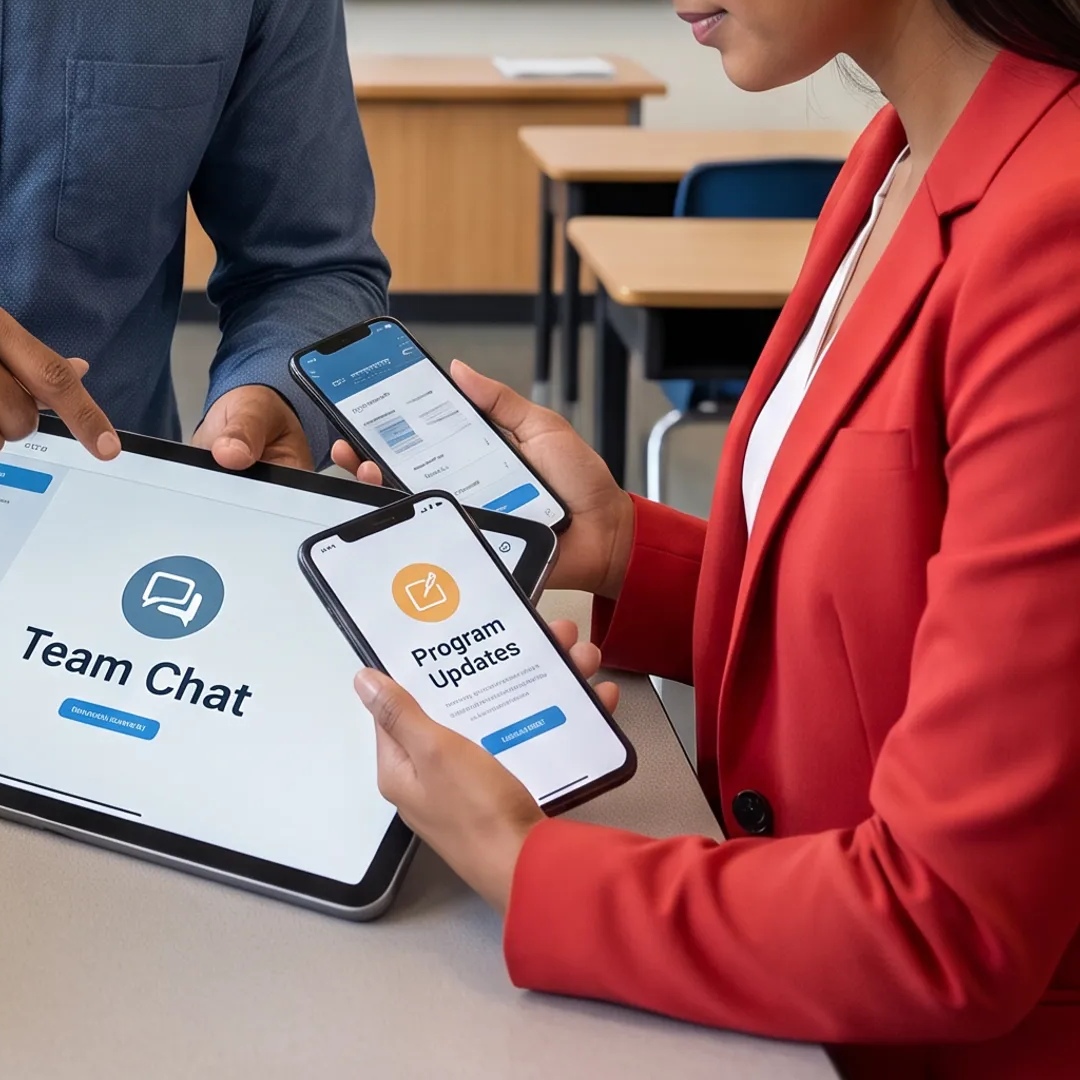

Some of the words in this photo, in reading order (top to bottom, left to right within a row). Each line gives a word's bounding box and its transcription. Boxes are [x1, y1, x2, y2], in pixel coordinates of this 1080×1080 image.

[410, 617, 507, 668] Program
[427, 640, 522, 690] Updates
[21, 625, 134, 687] Team
[145, 661, 254, 718] Chat
